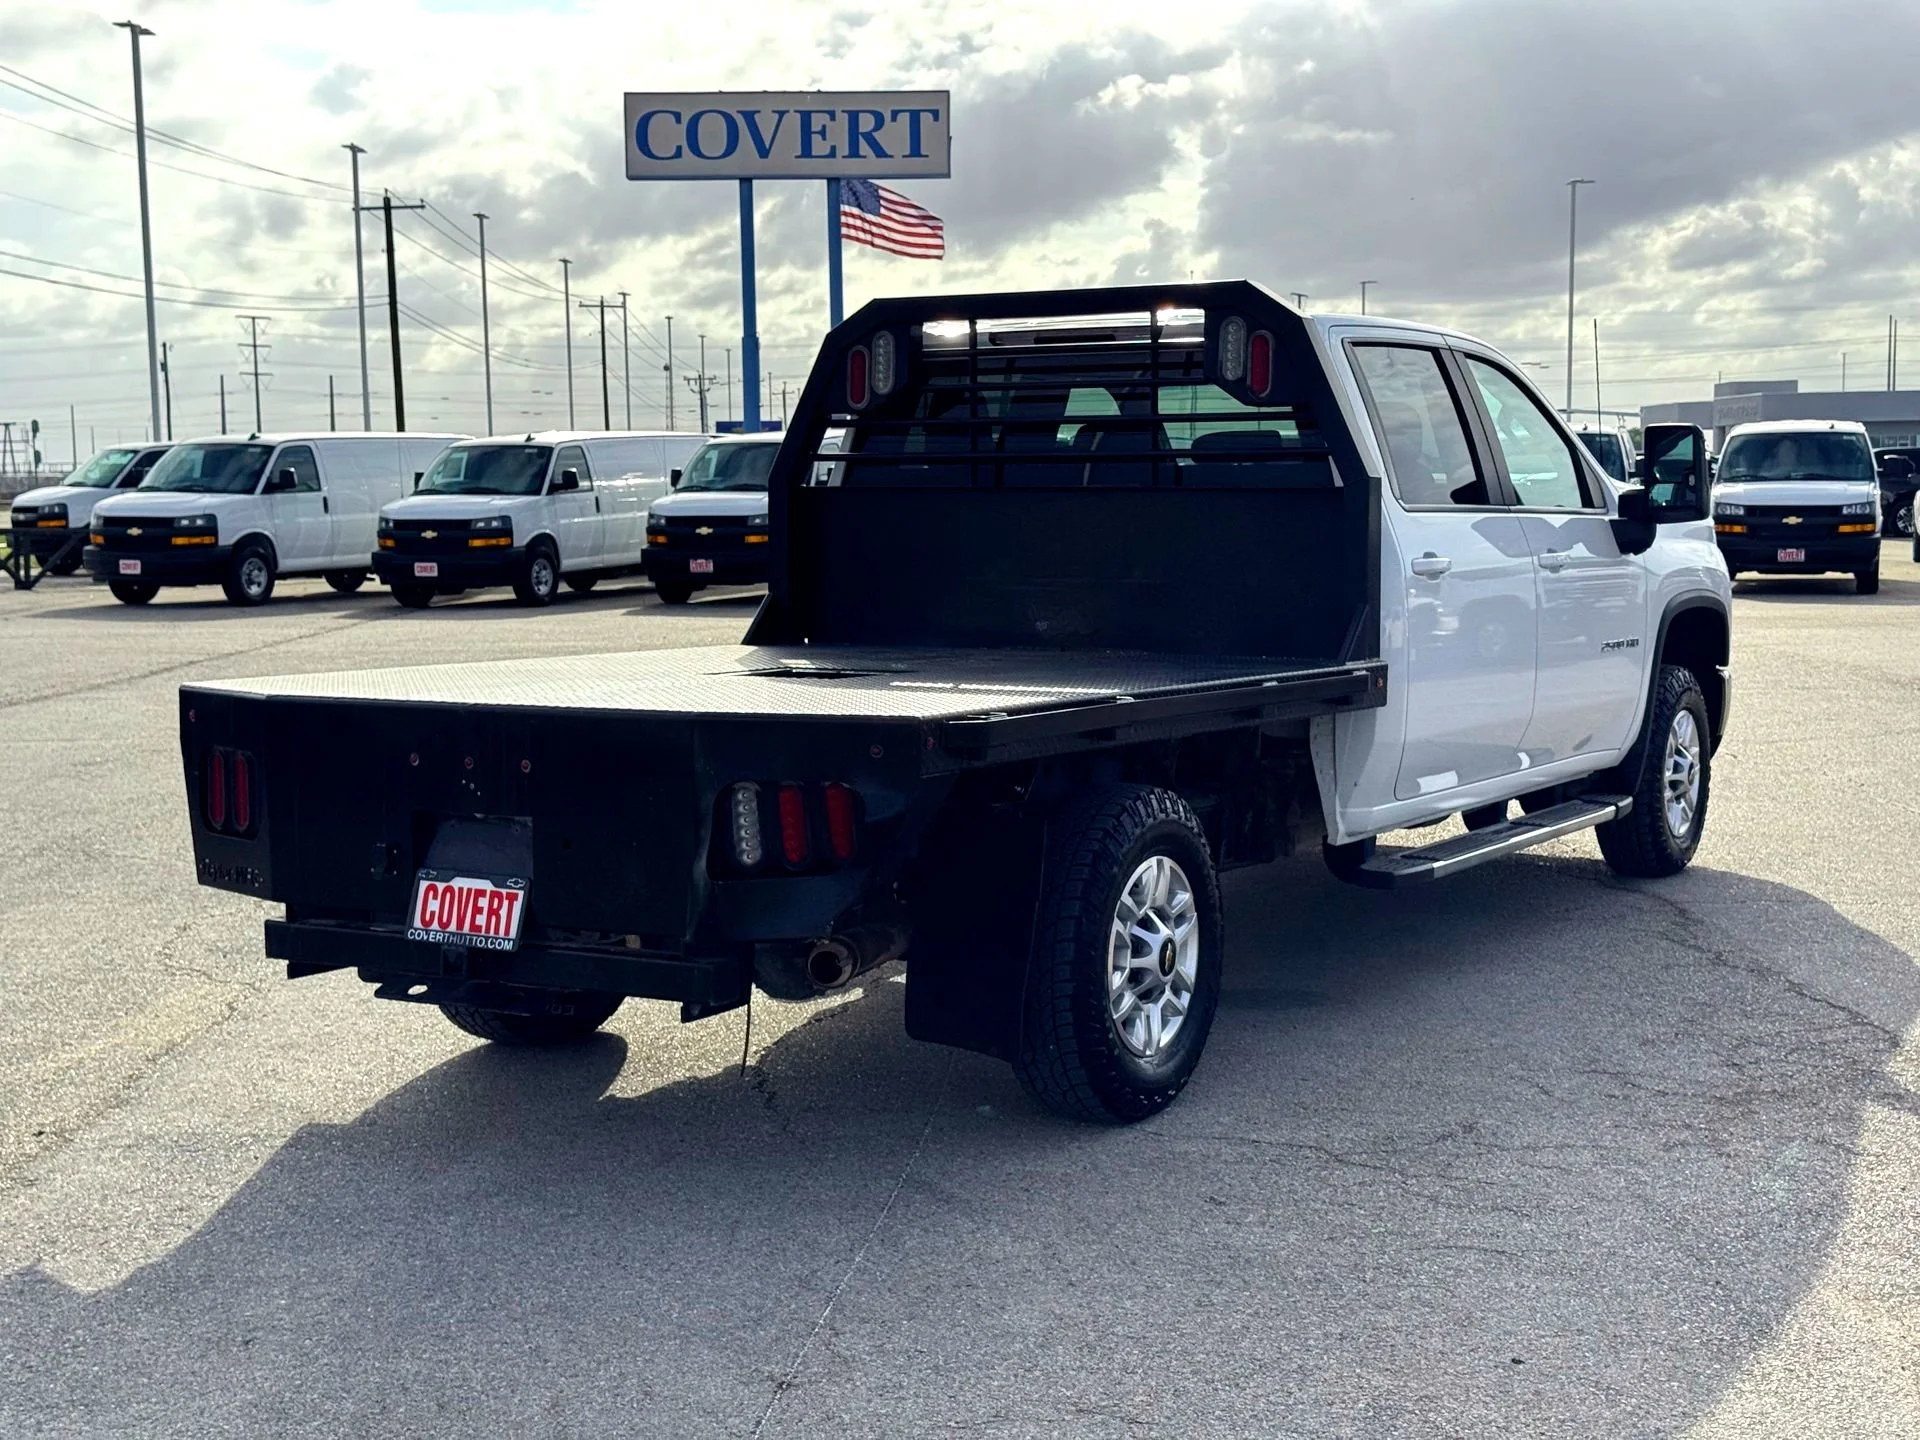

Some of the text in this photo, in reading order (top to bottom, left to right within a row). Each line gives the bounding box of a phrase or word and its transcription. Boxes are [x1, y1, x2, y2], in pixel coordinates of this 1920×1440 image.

[635, 108, 940, 161] COVERT
[420, 883, 519, 938] COVERT
[407, 928, 514, 951] COVERTHUTTO.COM
